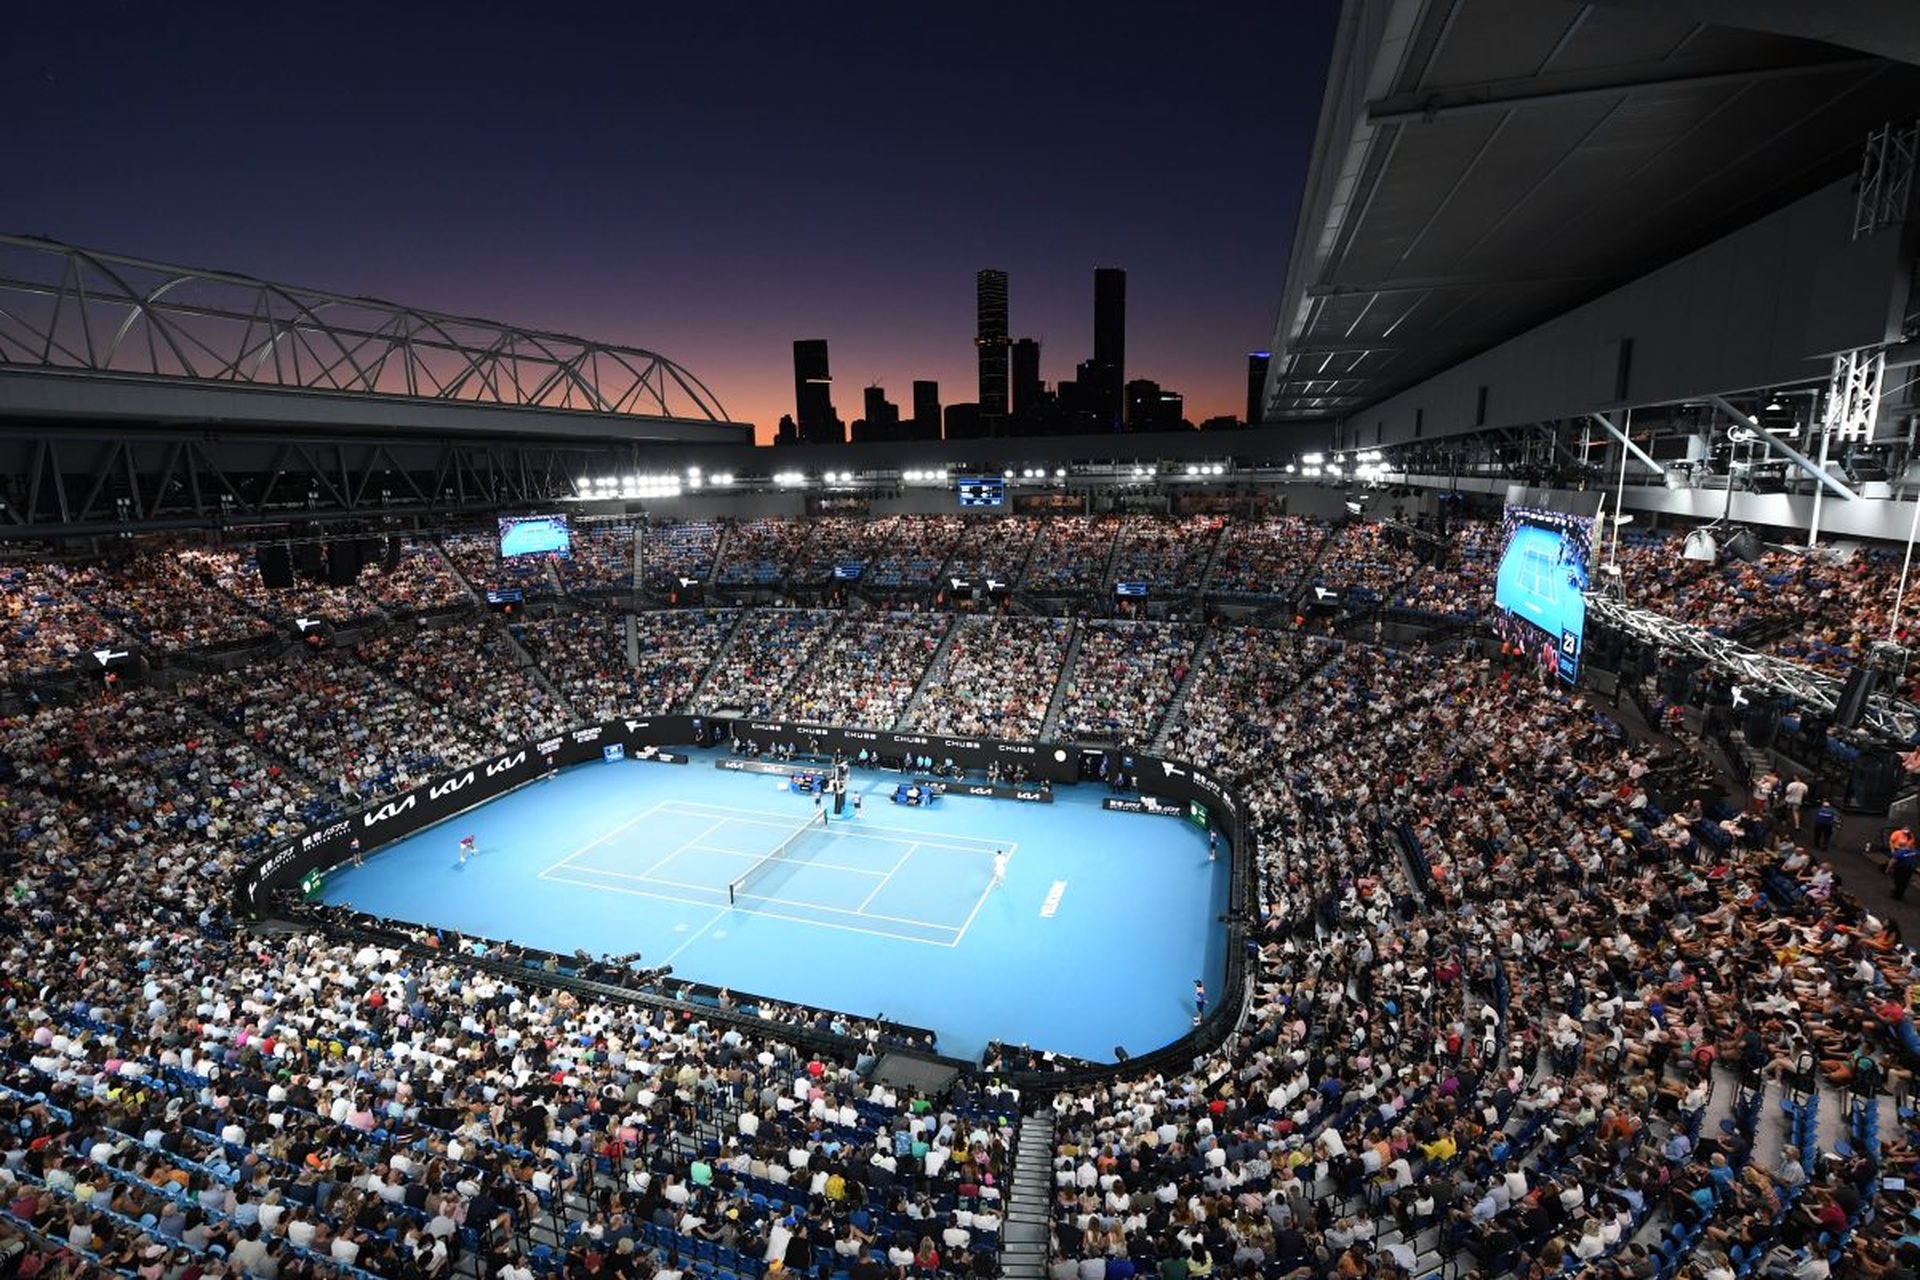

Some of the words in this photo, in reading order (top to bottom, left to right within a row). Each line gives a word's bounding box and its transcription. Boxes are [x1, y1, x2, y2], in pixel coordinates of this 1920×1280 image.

[1563, 632, 1576, 654] 23
[751, 723, 782, 731] CHUBB
[797, 727, 828, 735] CHUBB
[844, 731, 877, 739] CHUBB
[894, 735, 928, 744] CHUBB
[945, 740, 980, 749] CHUBB
[998, 745, 1035, 754] CHUBB
[486, 751, 526, 777] KIA
[429, 771, 475, 800] KIA
[364, 794, 416, 827] KIA
